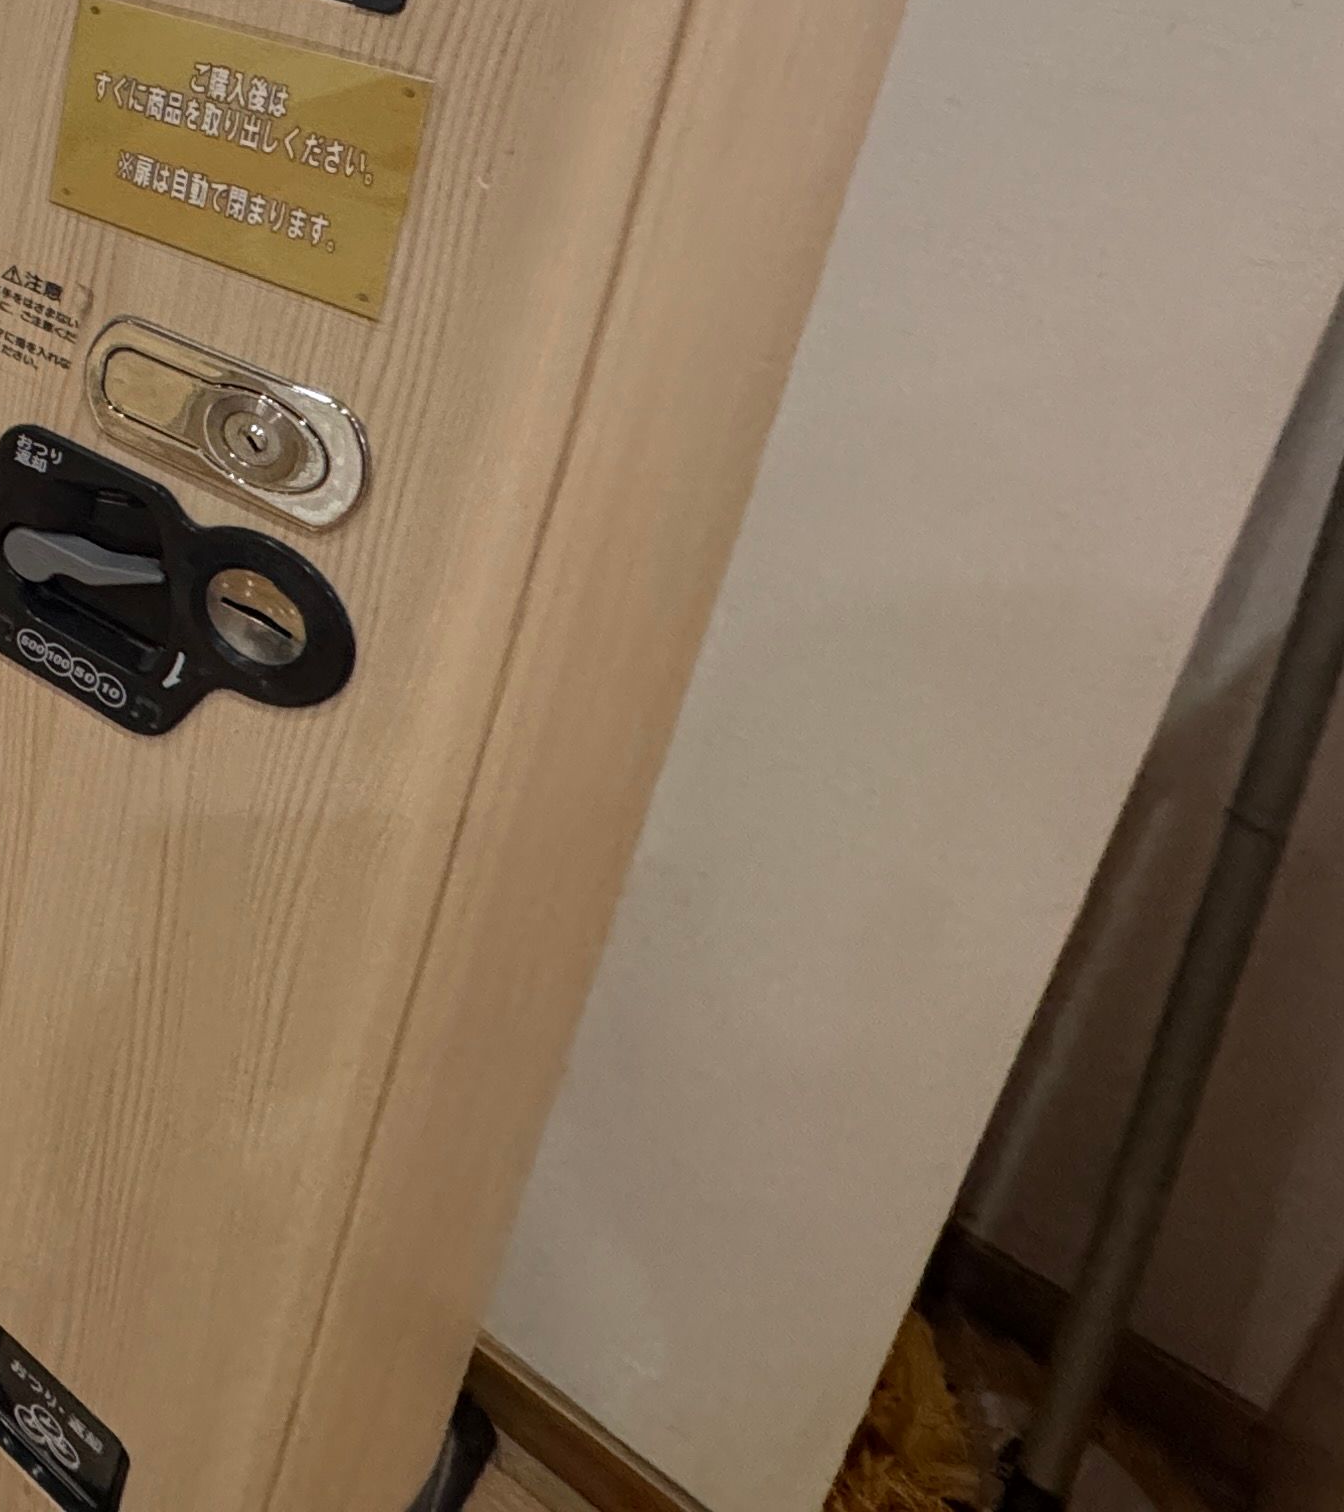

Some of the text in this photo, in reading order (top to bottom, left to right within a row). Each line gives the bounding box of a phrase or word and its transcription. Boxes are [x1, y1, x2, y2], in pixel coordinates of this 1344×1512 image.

[189, 62, 289, 117] ご購入後は
[94, 71, 376, 186] すぐに商品を取り出しください。
[24, 271, 64, 303] 注意
[16, 433, 63, 465] おつり
[20, 636, 46, 656] 500
[47, 649, 70, 670] 100
[72, 666, 95, 685] 50
[101, 681, 120, 700] 10
